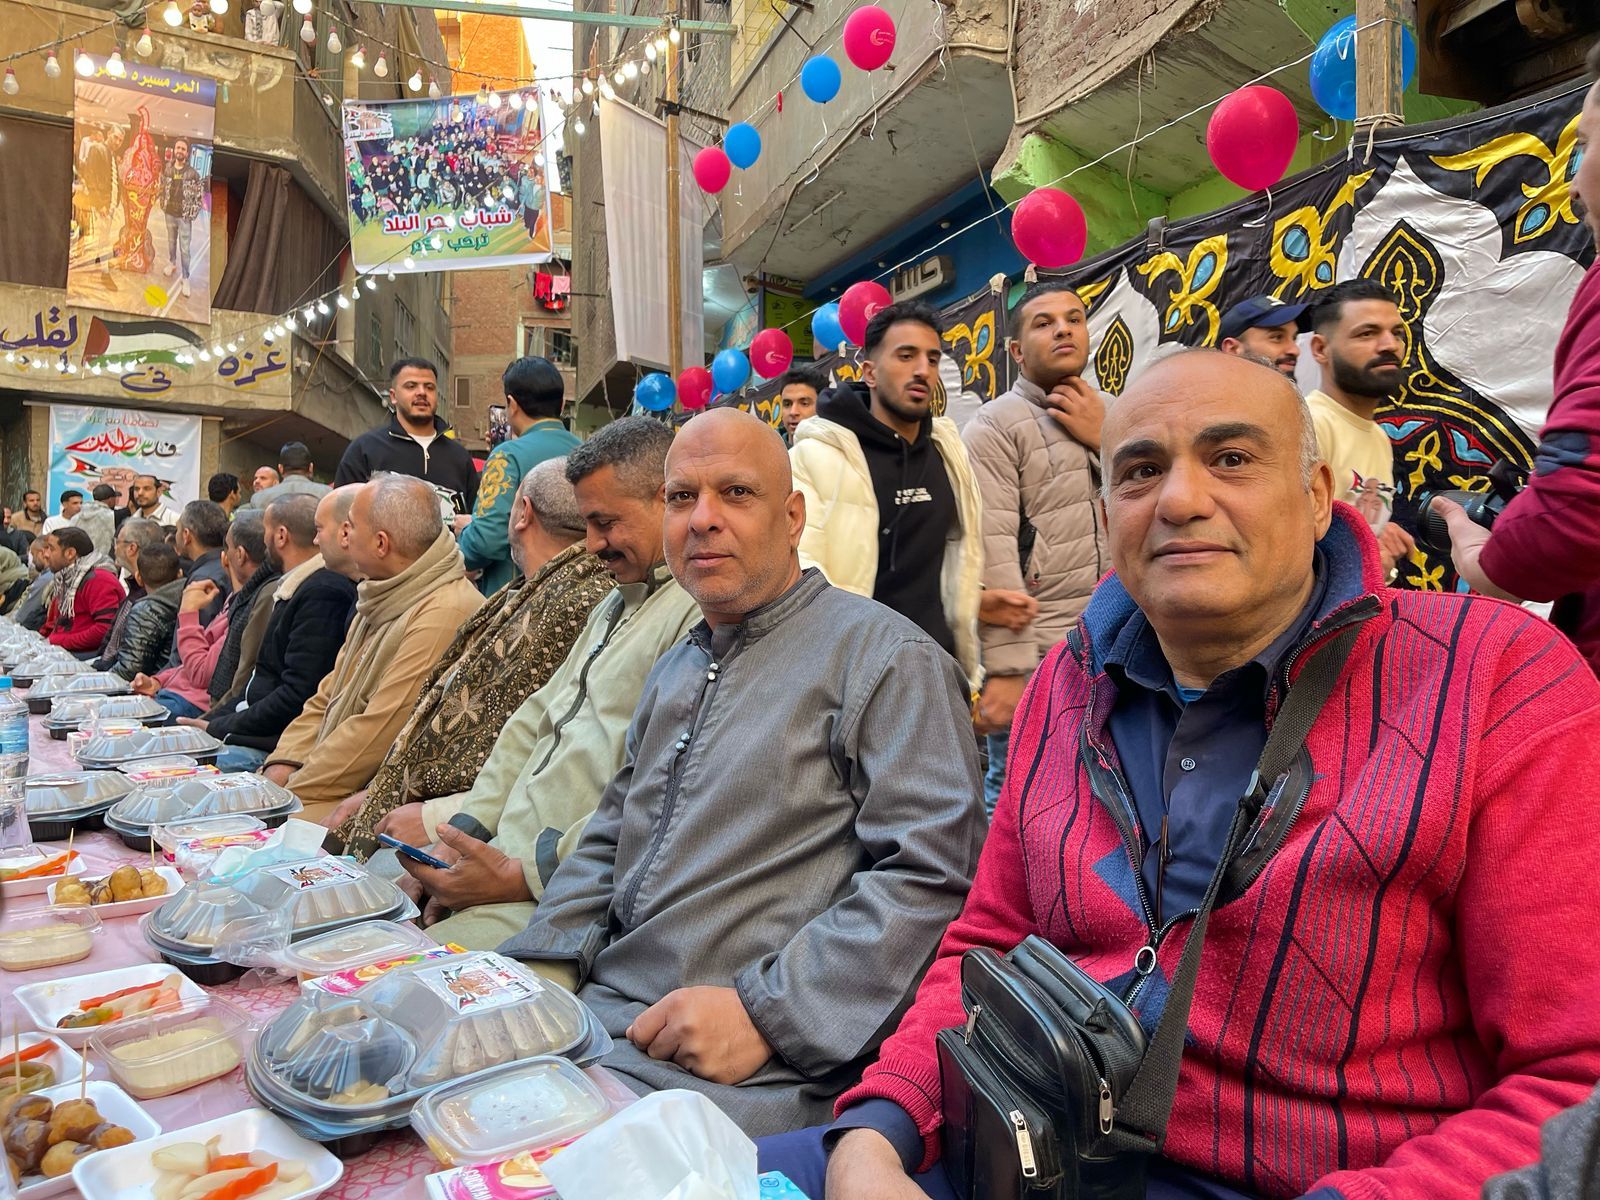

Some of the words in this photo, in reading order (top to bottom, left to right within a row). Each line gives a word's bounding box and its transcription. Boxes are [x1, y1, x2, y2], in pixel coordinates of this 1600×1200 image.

[171, 80, 200, 94] المر
[385, 214, 419, 235] البلد
[460, 206, 512, 231] شباب
[447, 232, 489, 252] ترحب
[65, 427, 177, 458] فلسطين
